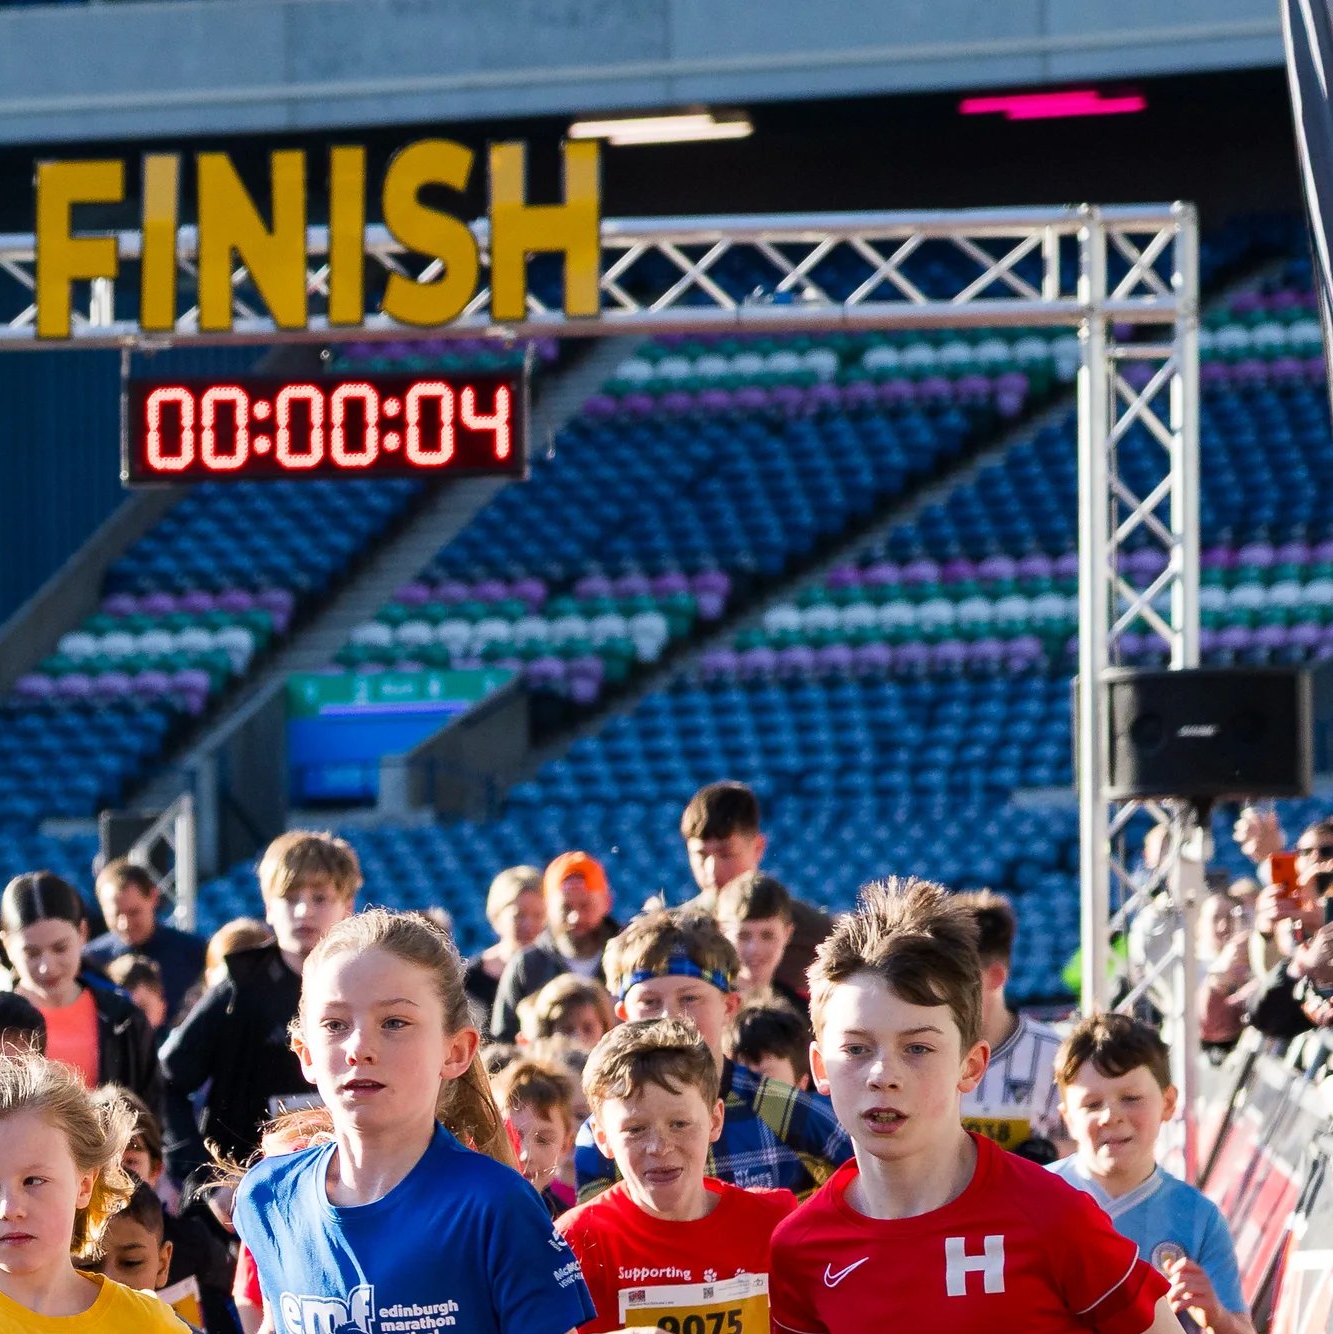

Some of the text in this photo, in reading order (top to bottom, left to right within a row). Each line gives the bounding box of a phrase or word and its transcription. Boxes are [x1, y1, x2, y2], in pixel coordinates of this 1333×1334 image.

[35, 138, 602, 340] FINISH
[146, 382, 511, 472] 00:00:04
[618, 1266, 692, 1281] Supporting
[945, 1235, 1005, 1296] H
[379, 1299, 459, 1321] edinburgh
[381, 1314, 456, 1332] marathon
